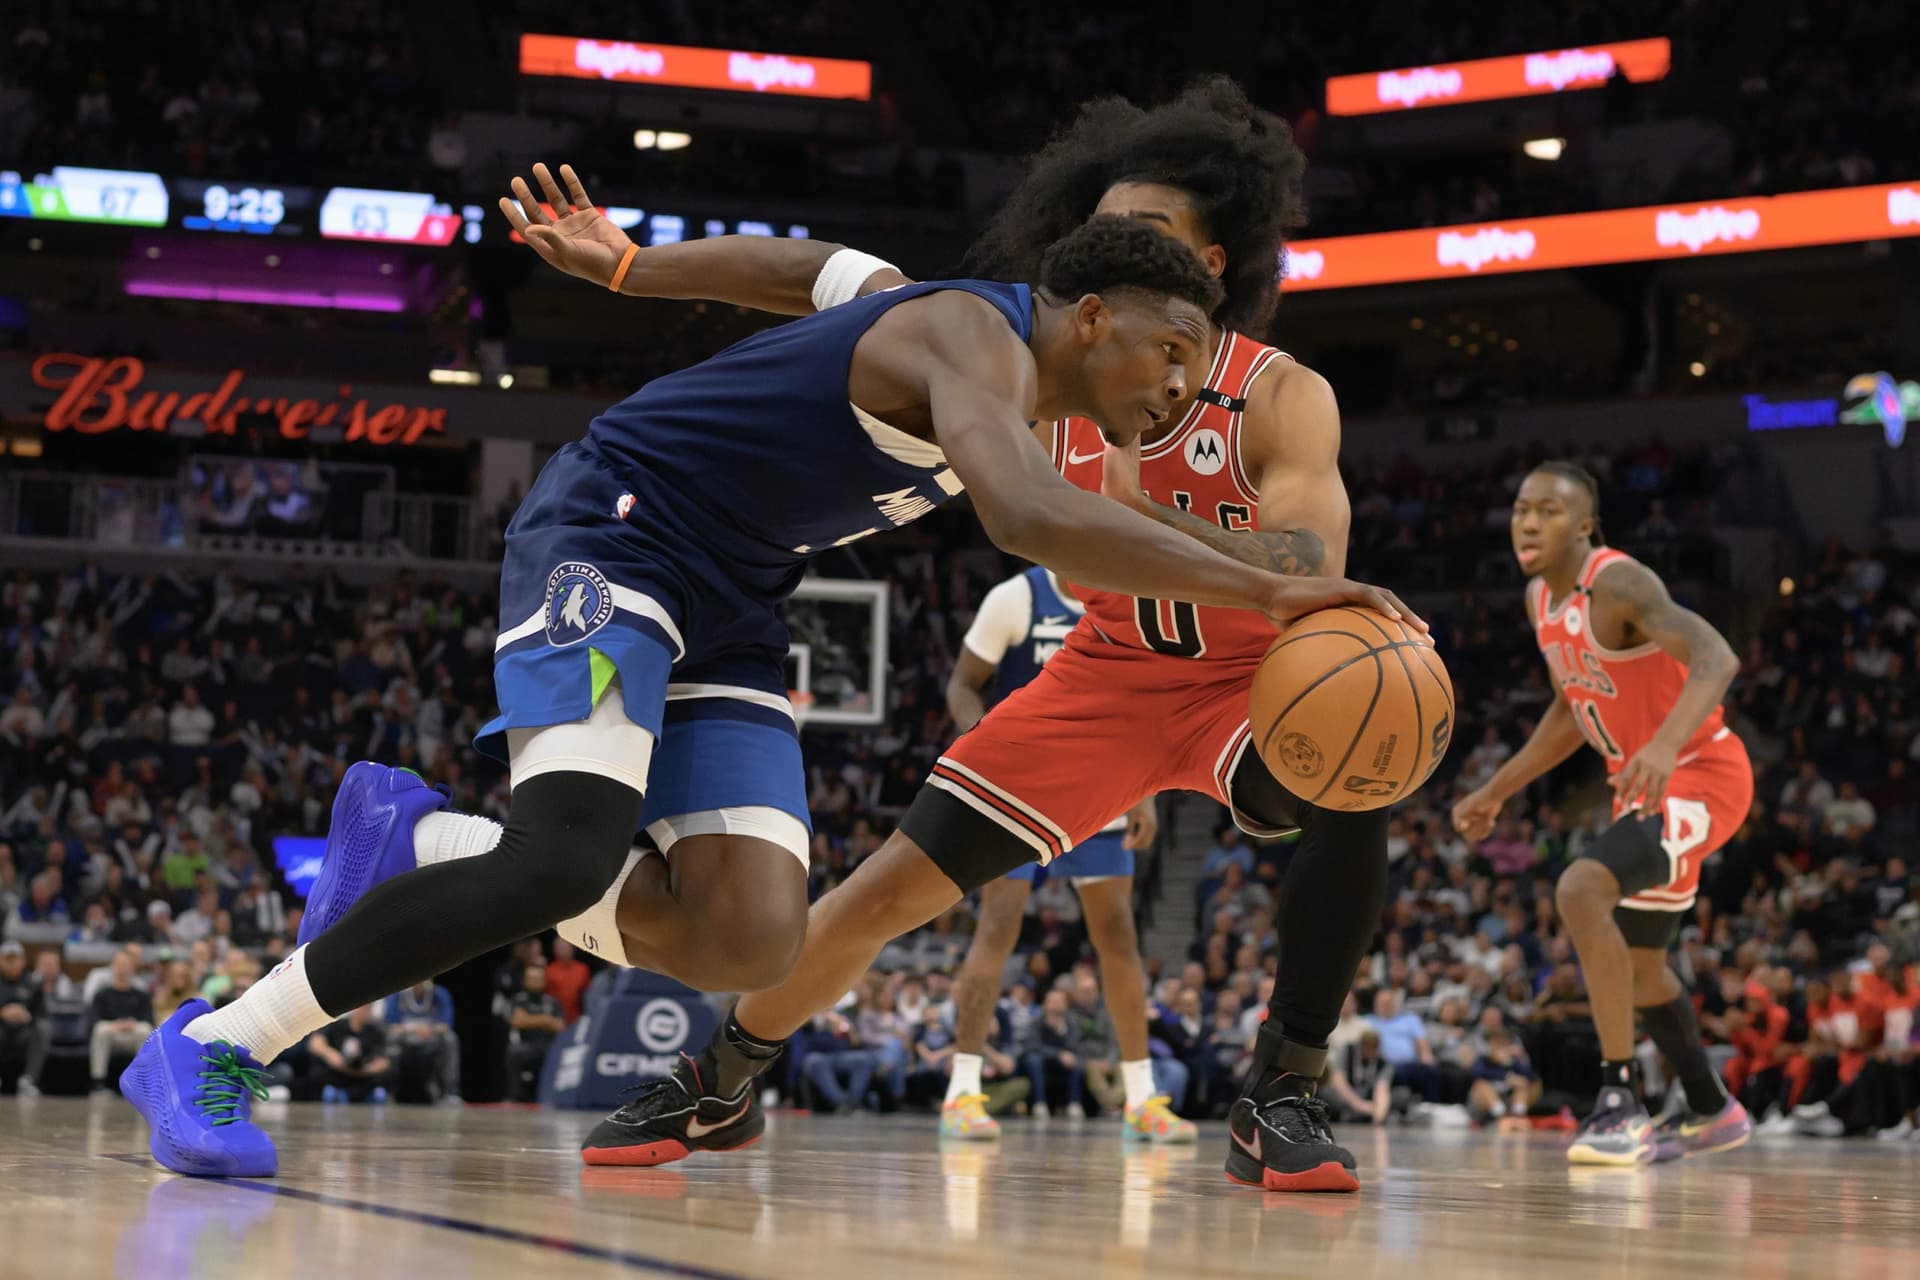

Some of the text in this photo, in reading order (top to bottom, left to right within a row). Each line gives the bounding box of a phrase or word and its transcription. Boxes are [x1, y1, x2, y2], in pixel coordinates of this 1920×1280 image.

[101, 187, 139, 218] 67
[204, 186, 284, 224] 9:25
[1219, 395, 1232, 408] 10
[569, 565, 610, 625] TIMBERWOLVES
